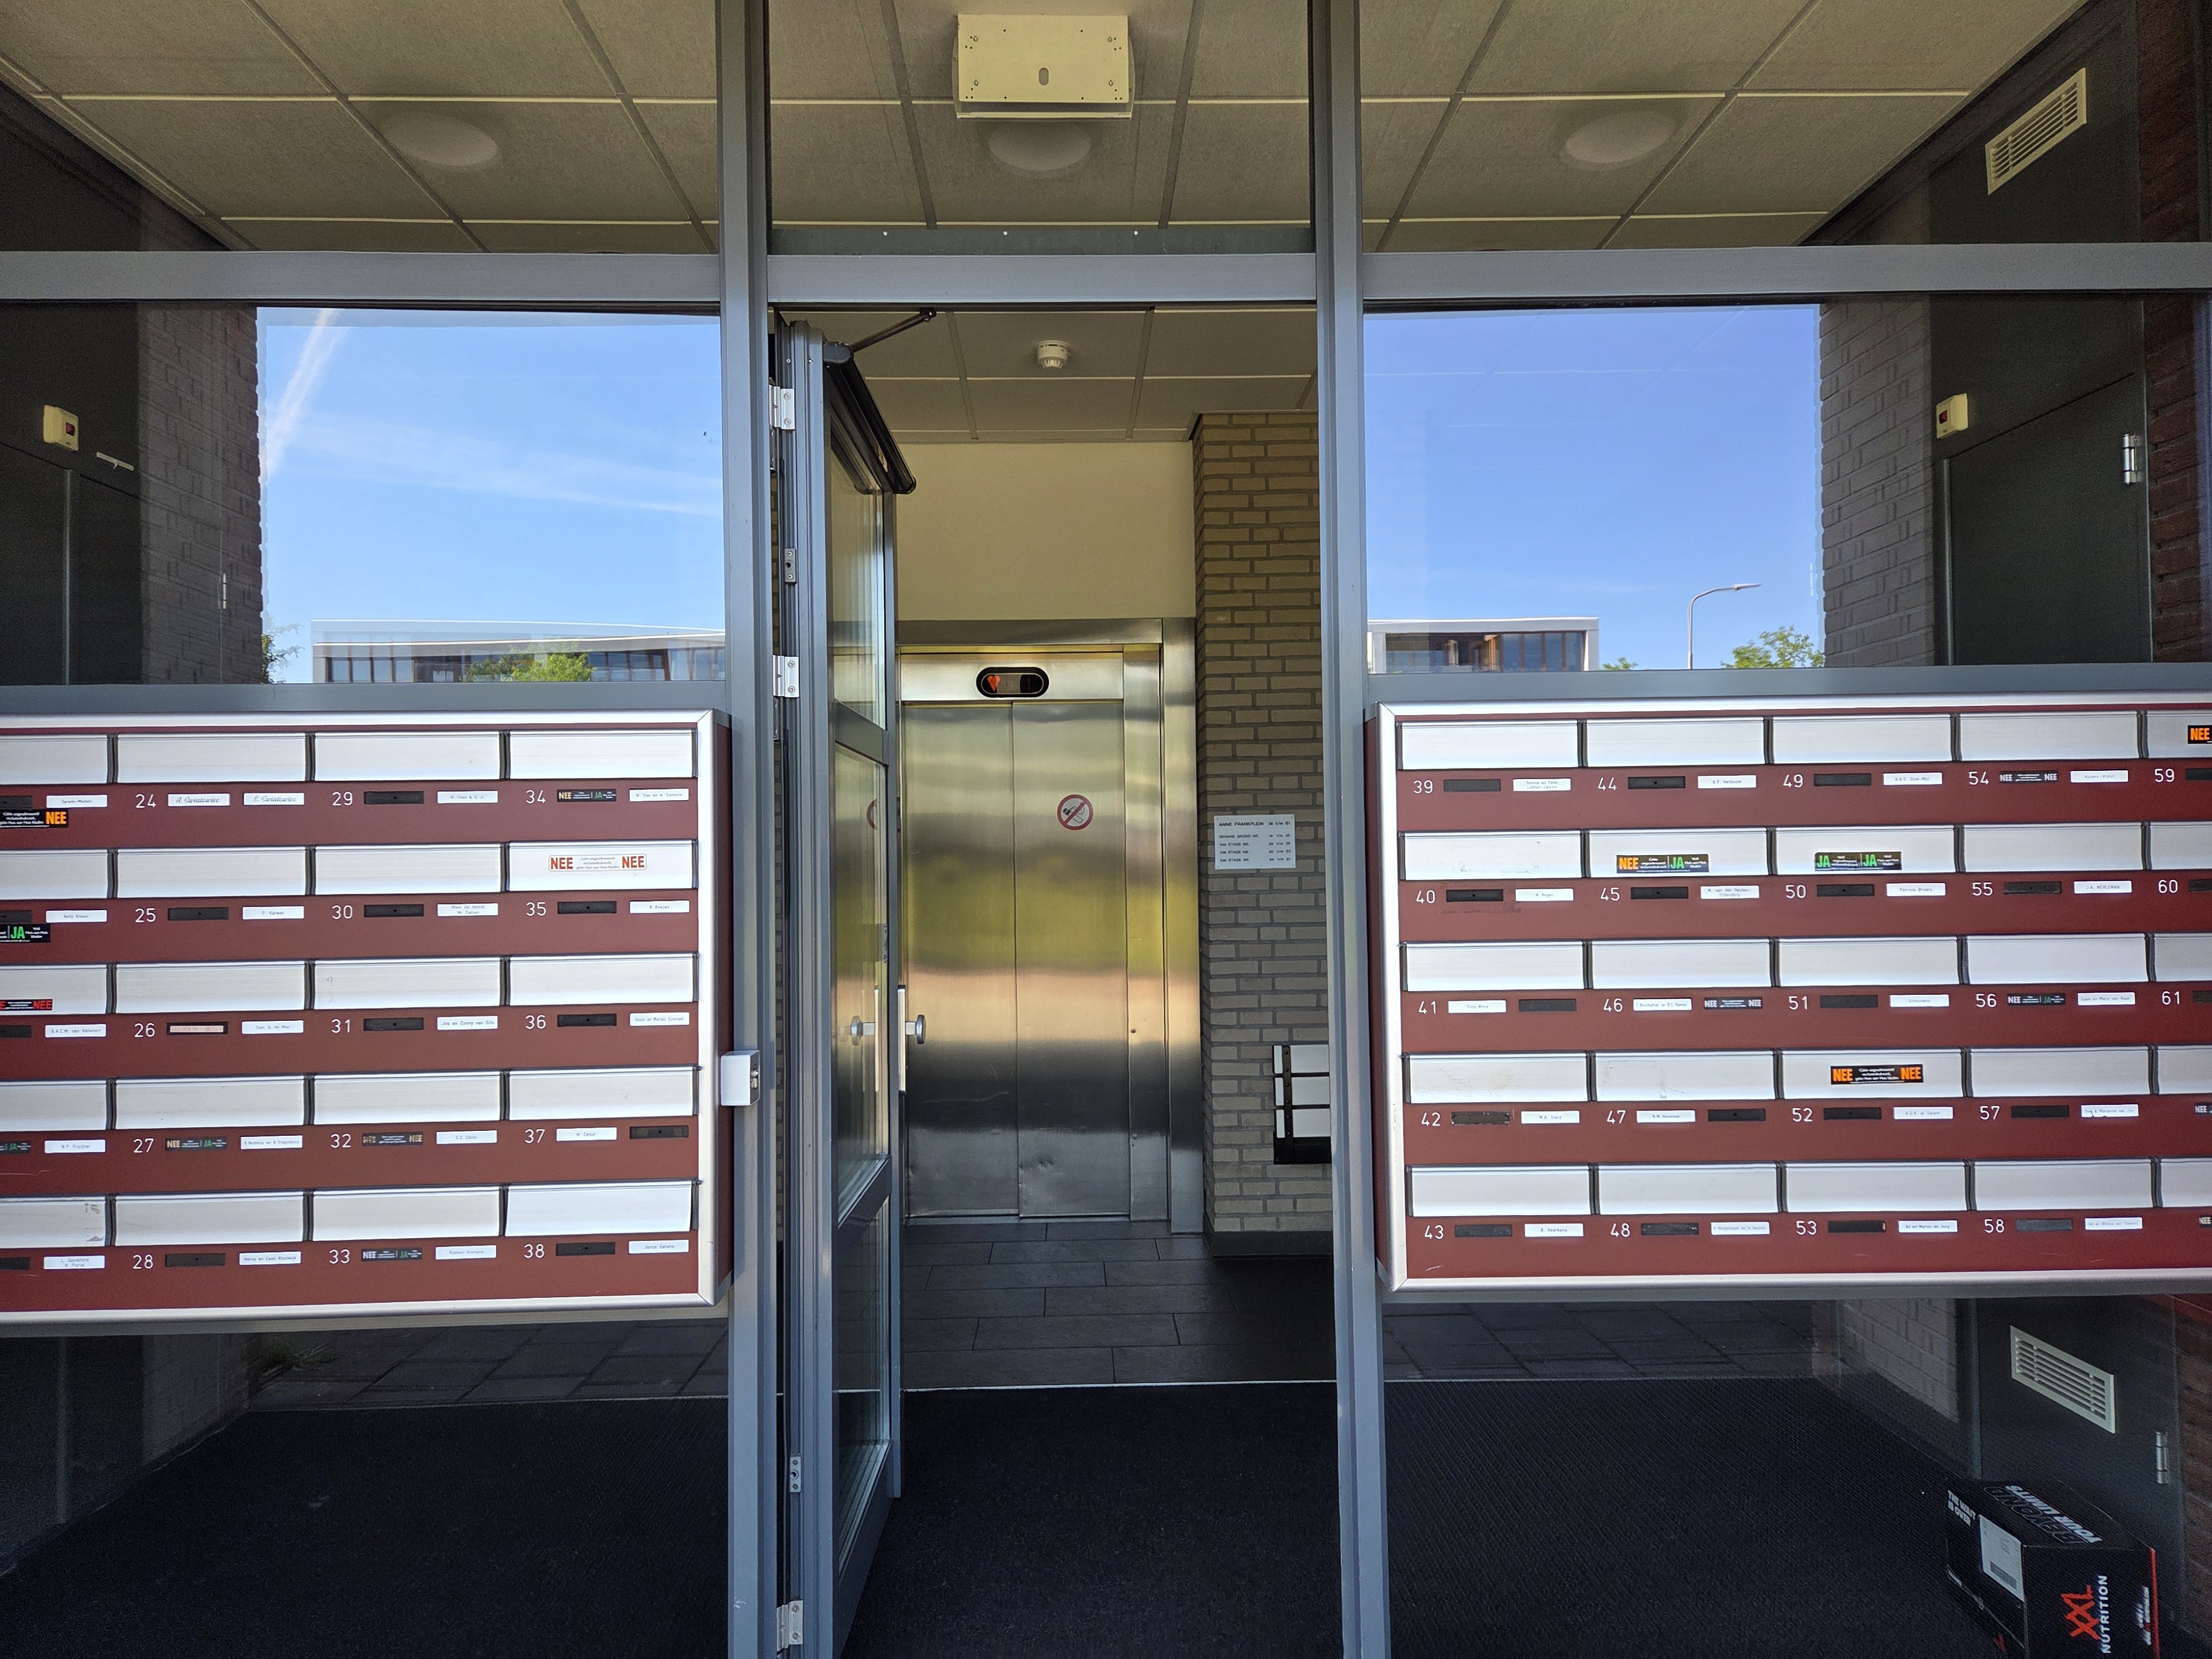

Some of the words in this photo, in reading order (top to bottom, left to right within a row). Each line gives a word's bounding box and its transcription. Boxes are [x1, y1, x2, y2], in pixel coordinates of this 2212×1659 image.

[2190, 728, 2210, 740] NEE
[1782, 774, 1803, 788] 49
[1968, 771, 1989, 785] 54
[2000, 774, 2013, 782] NEE
[2154, 768, 2174, 782] 59
[1413, 780, 1433, 794] 39
[1597, 777, 1617, 791] 44
[135, 794, 156, 808] 24
[332, 791, 353, 806] 29
[525, 789, 546, 804] 34
[559, 791, 572, 800] NEE
[45, 811, 67, 825] NEE
[551, 857, 573, 870] NEE
[622, 855, 645, 868] NEE
[1619, 857, 1639, 870] NEE
[1670, 857, 1685, 869] JA
[1817, 855, 1831, 868] JA
[1863, 854, 1877, 867] JA
[1600, 887, 1620, 901] 45
[1785, 884, 1806, 899] 50
[1972, 882, 1993, 896] 55
[2158, 879, 2178, 894] 60
[1416, 890, 1436, 904] 40
[135, 907, 156, 923] 25
[332, 905, 353, 920] 30
[526, 901, 546, 916] 35
[11, 926, 25, 939] JA
[33, 1000, 53, 1009] NEE
[1788, 995, 1808, 1010] 51
[1976, 993, 1997, 1008] 56
[2162, 990, 2180, 1005] 61
[1418, 1000, 1436, 1015] 41
[1603, 998, 1623, 1013] 46
[134, 1022, 155, 1037] 26
[331, 1019, 350, 1034] 31
[525, 1014, 546, 1030] 36
[1832, 1068, 1853, 1082] NEE
[1901, 1067, 1921, 1080] NEE
[1421, 1112, 1441, 1126] 42
[1606, 1110, 1626, 1124] 47
[1792, 1108, 1813, 1122] 52
[1980, 1105, 2000, 1120] 57
[166, 1140, 181, 1148] NEE
[330, 1133, 352, 1148] 32
[409, 1135, 422, 1143] NEE
[525, 1129, 545, 1144] 37
[133, 1138, 154, 1153] 27
[1424, 1224, 1444, 1239] 43
[1610, 1223, 1630, 1238] 48
[1796, 1220, 1817, 1235] 53
[1984, 1219, 2005, 1233] 58
[329, 1249, 350, 1264] 33
[363, 1251, 377, 1259] NEE
[524, 1244, 545, 1259] 38
[132, 1254, 153, 1269] 28
[1948, 1489, 1959, 1506] THE
[1959, 1499, 1976, 1521] WAIT
[2005, 1485, 2061, 1515] LIMITS
[1948, 1499, 1954, 1512] IS
[1954, 1506, 1971, 1527] OVER
[2053, 1515, 2103, 1543] YOUR
[2060, 1584, 2101, 1641] XXL
[2098, 1575, 2111, 1653] NUTRITION
